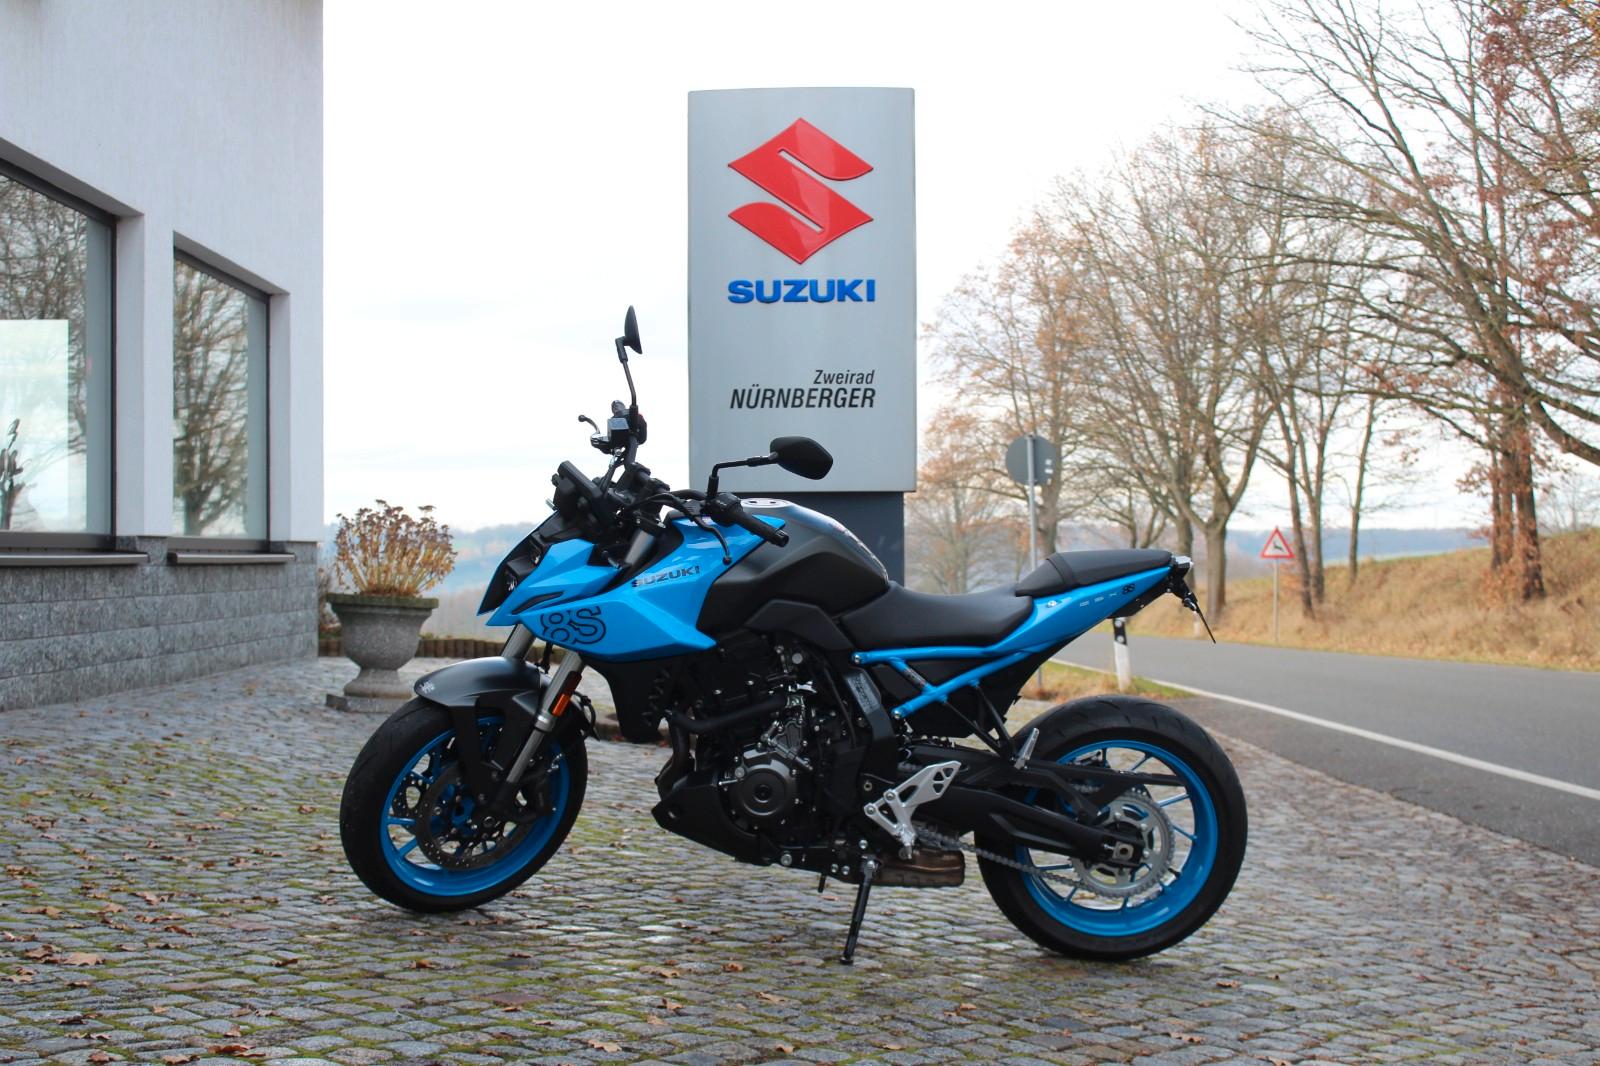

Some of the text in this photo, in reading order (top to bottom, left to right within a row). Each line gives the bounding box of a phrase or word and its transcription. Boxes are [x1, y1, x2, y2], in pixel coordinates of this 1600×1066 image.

[728, 279, 876, 304] SUZUKI
[813, 369, 875, 385] Zweirad
[730, 384, 876, 409] NÜRNBERGER
[631, 565, 700, 588] SUZUKI
